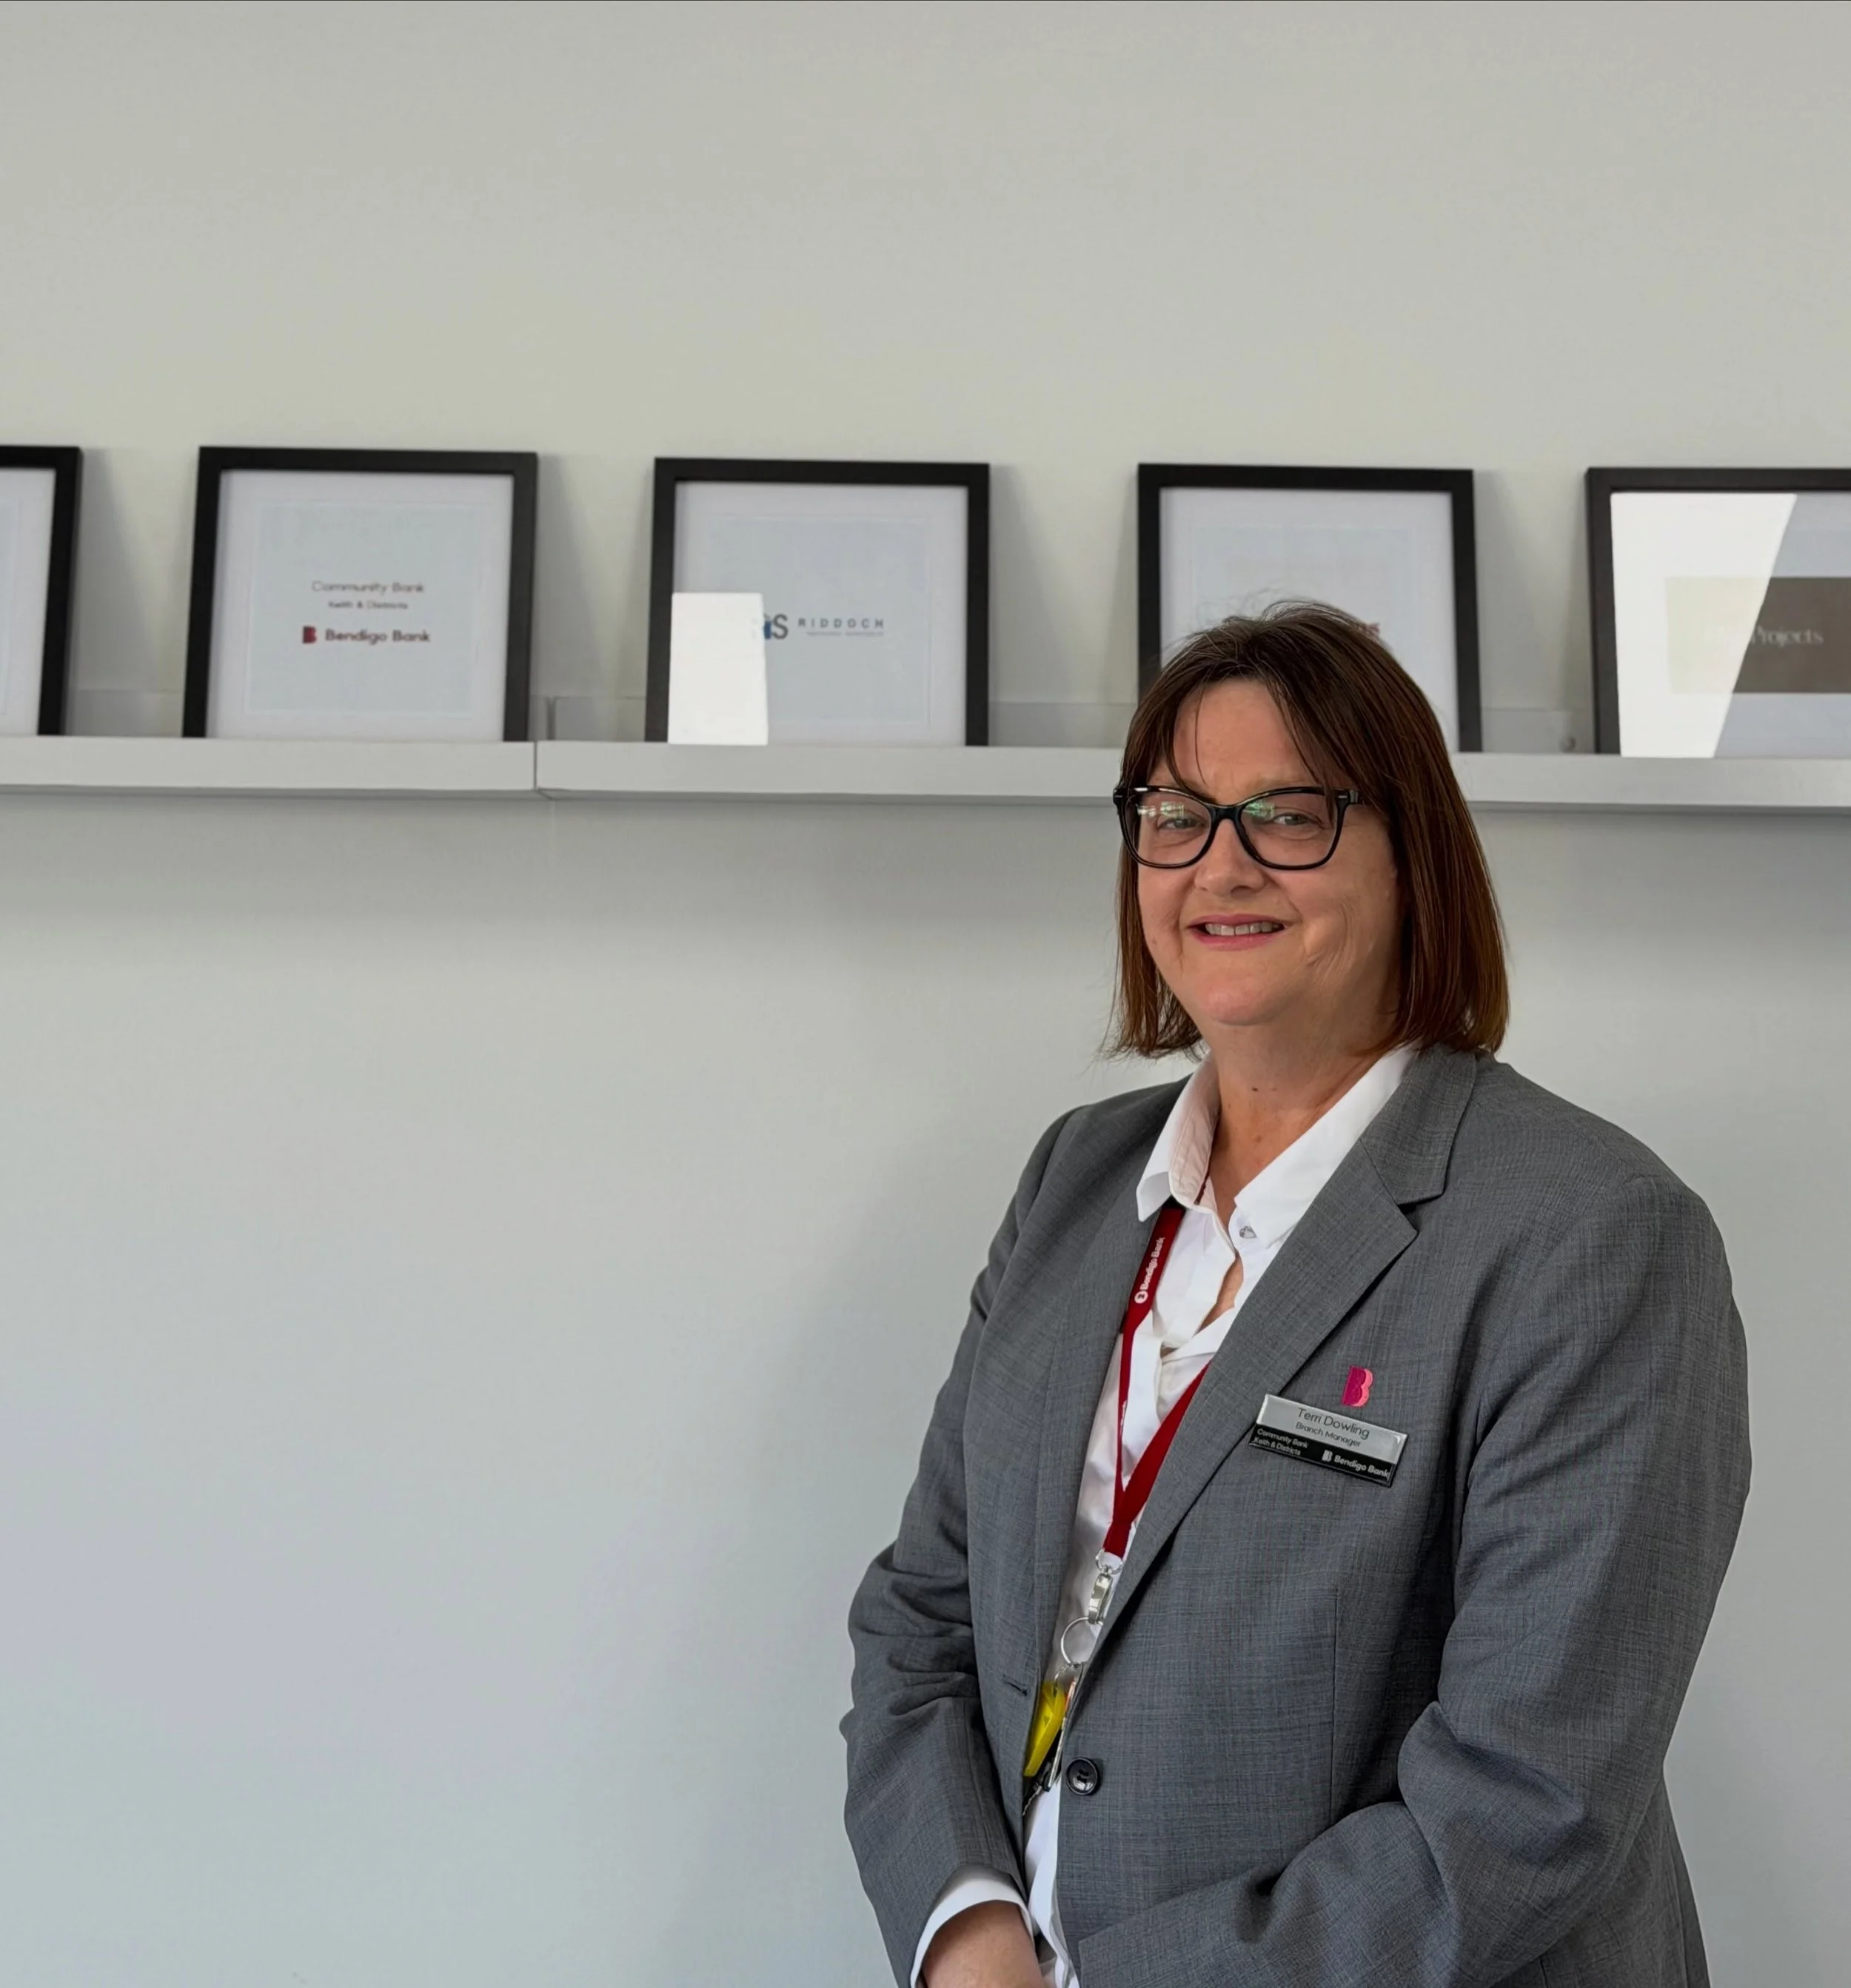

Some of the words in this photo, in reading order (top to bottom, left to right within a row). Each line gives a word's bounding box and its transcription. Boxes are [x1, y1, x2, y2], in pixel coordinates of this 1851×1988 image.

[312, 581, 386, 595] Community
[392, 582, 424, 593] Bank
[797, 618, 884, 629] RIDDOCH
[325, 628, 388, 646] Bendigo
[392, 630, 430, 643] Bank
[1139, 1258, 1158, 1290] Bendigo
[1151, 1237, 1165, 1258] Bank
[1298, 1408, 1322, 1424] Terri
[1324, 1415, 1370, 1440] Dowling
[1257, 1428, 1292, 1444] Community
[1292, 1437, 1308, 1449] Bank
[1296, 1422, 1324, 1437] Branch
[1325, 1430, 1362, 1448] Manager
[1253, 1436, 1270, 1447] Keith
[1270, 1441, 1276, 1449] &
[1276, 1442, 1302, 1456] Districts
[1333, 1454, 1367, 1472] Bendigo
[1368, 1462, 1390, 1479] Bank
